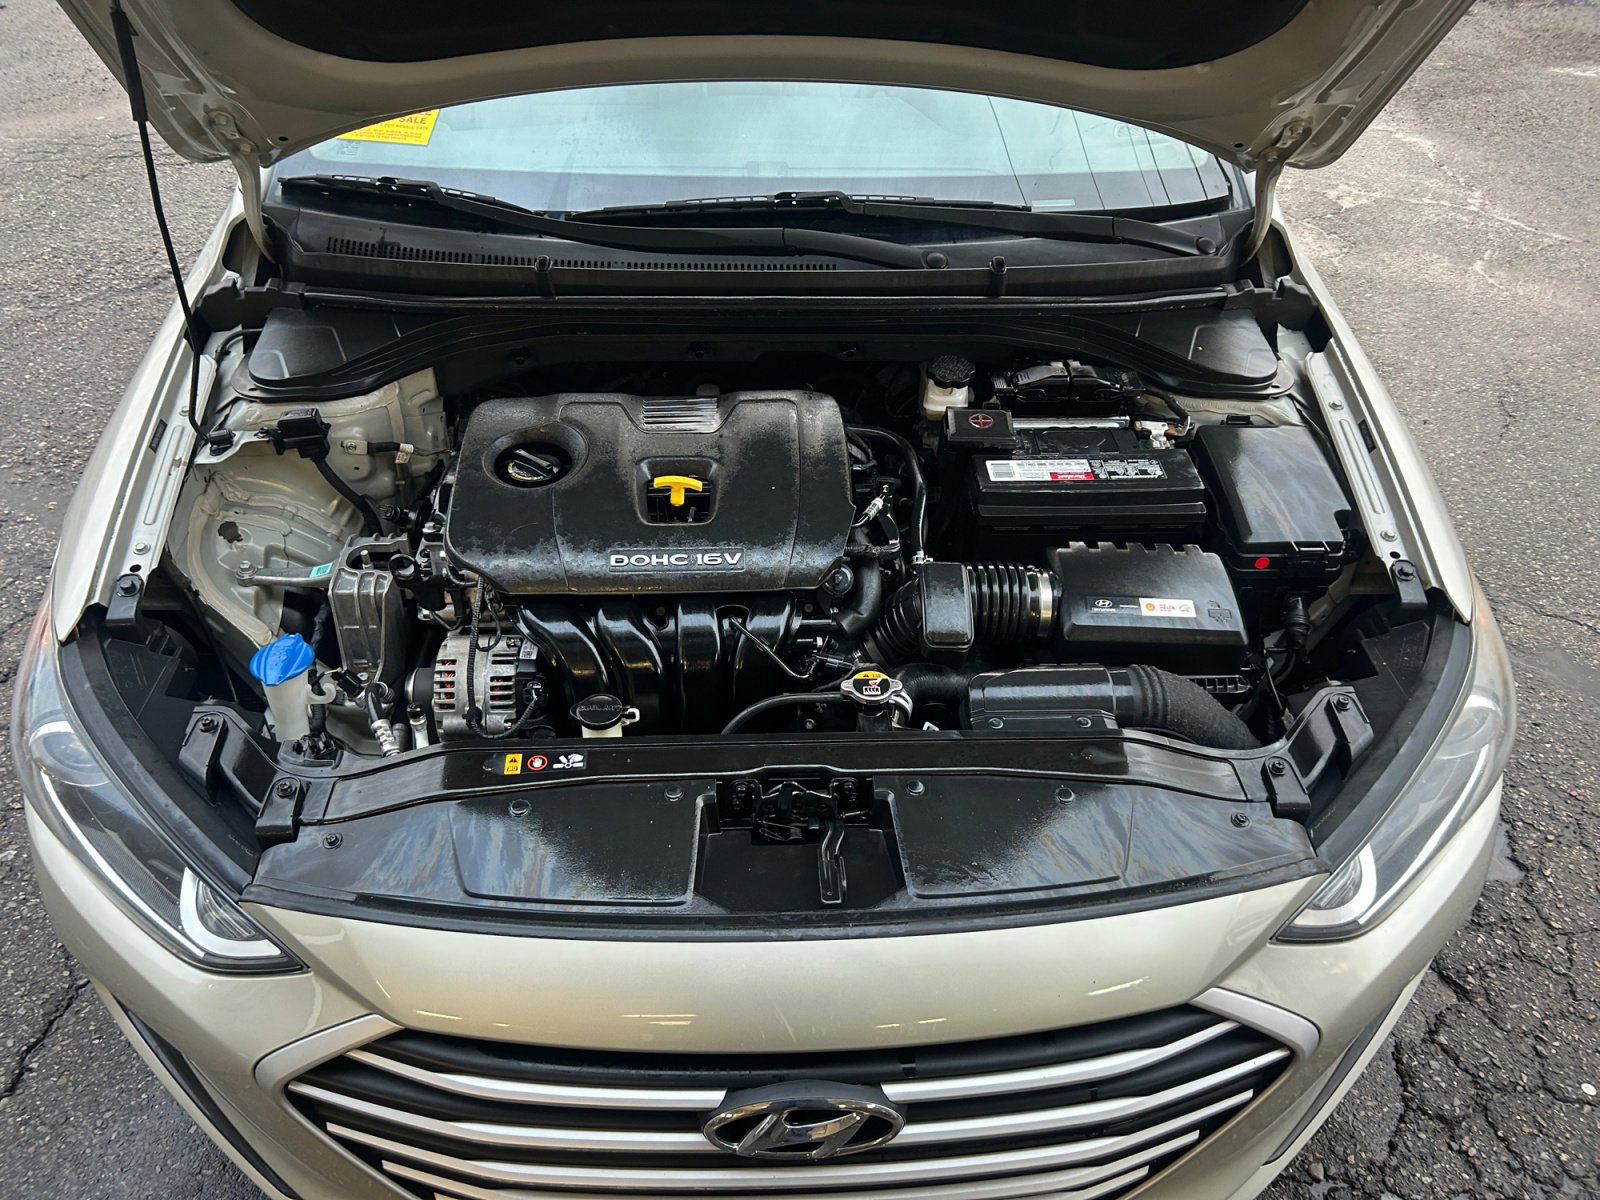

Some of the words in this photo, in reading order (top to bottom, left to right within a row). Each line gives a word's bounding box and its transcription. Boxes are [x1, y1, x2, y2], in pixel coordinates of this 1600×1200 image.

[399, 116, 428, 124] SALE
[609, 554, 688, 566] DOHC
[696, 552, 742, 565] 16V
